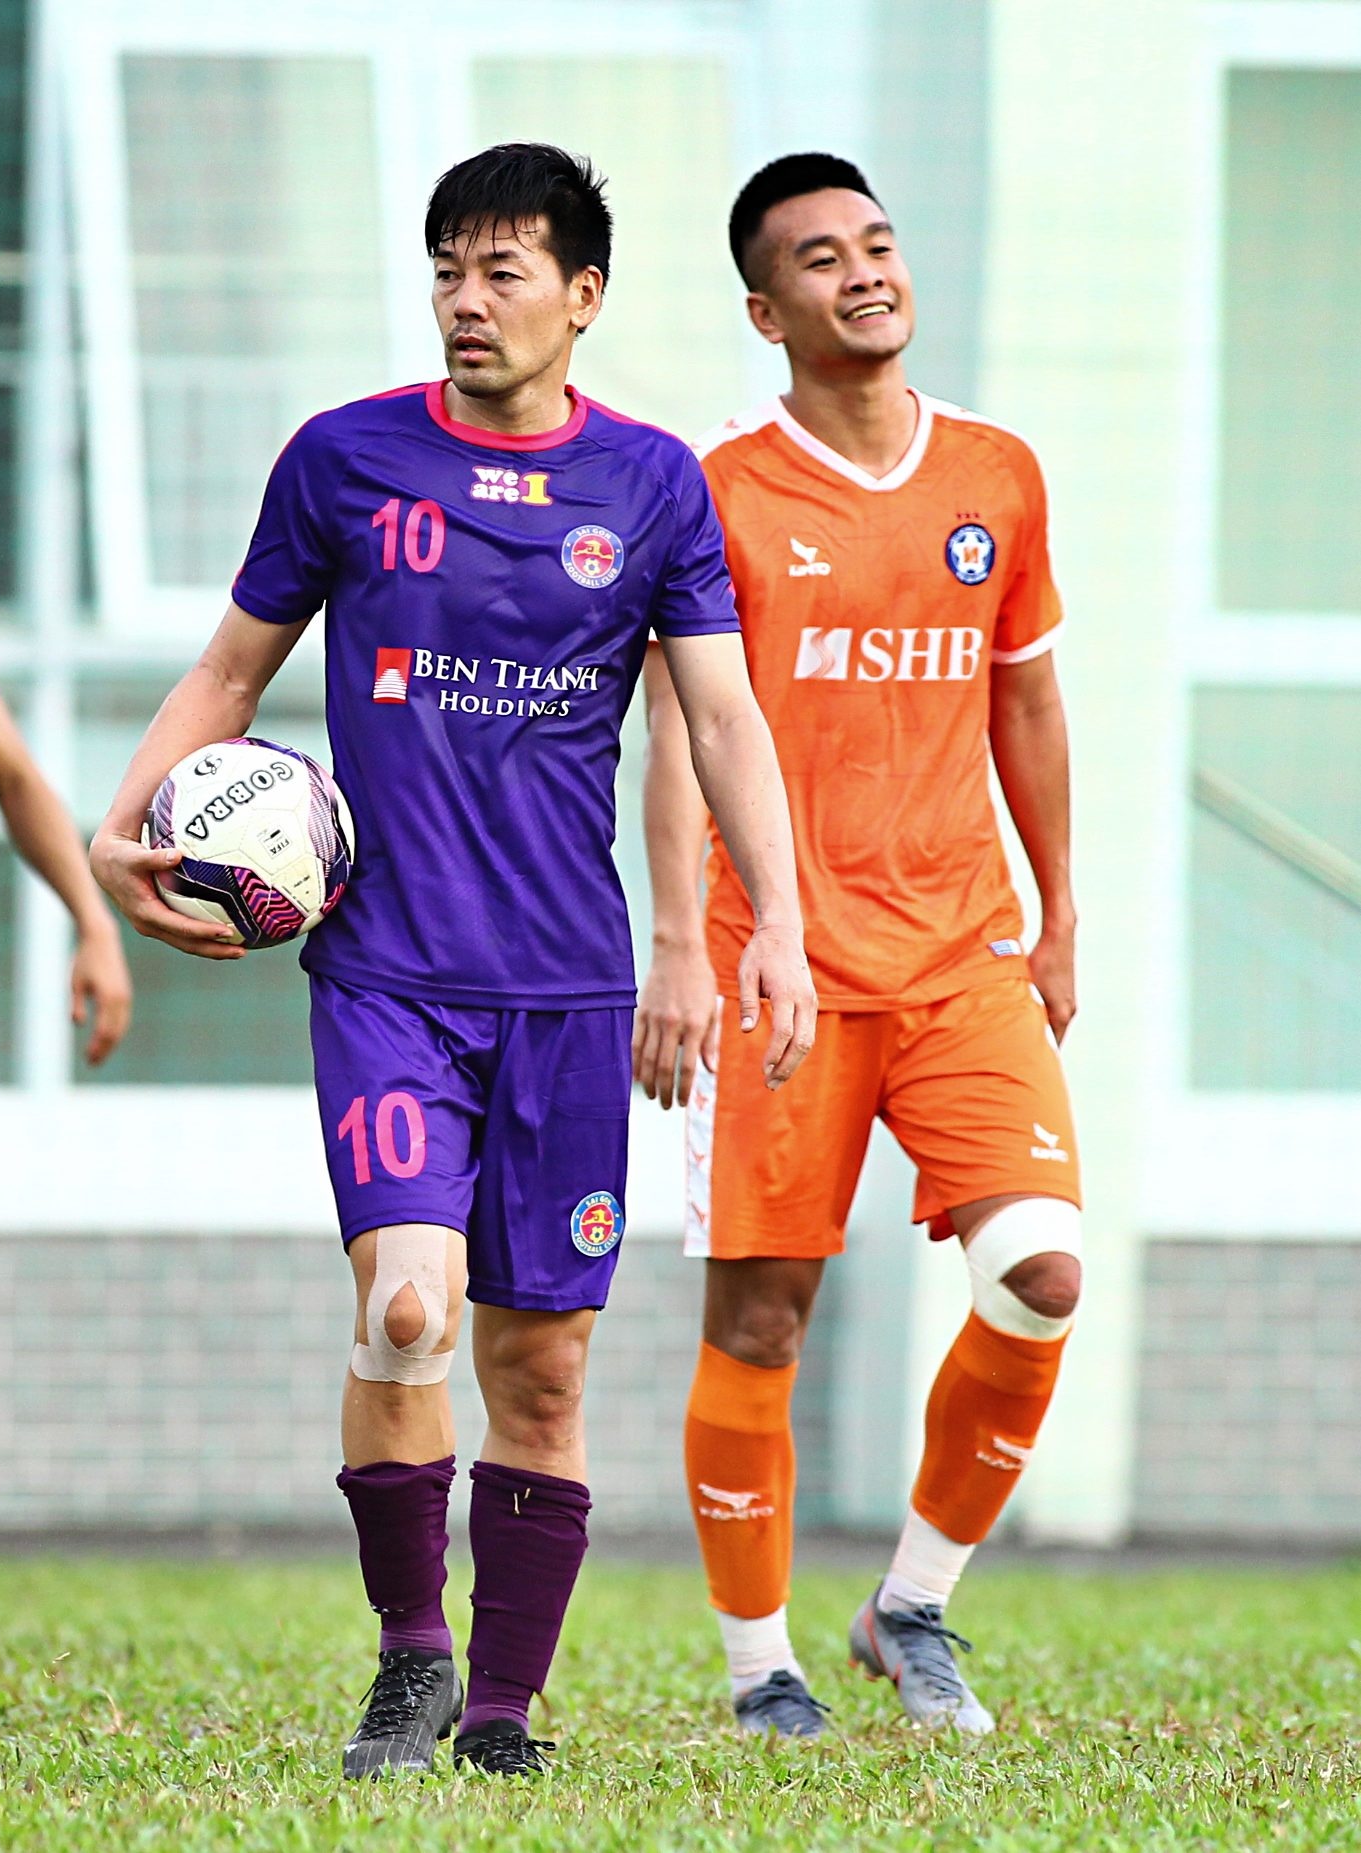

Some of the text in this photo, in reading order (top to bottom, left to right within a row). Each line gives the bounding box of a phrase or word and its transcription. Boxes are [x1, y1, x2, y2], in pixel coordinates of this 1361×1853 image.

[471, 473, 551, 504] are 1
[472, 467, 520, 487] we
[371, 498, 446, 573] 10
[565, 562, 619, 587] FOOTBALL CLUB
[412, 648, 600, 692] BEN THANH
[856, 627, 985, 682] SHB
[438, 690, 571, 718] HOLDINGS
[185, 761, 294, 841] COBRA
[338, 1091, 428, 1185] 10
